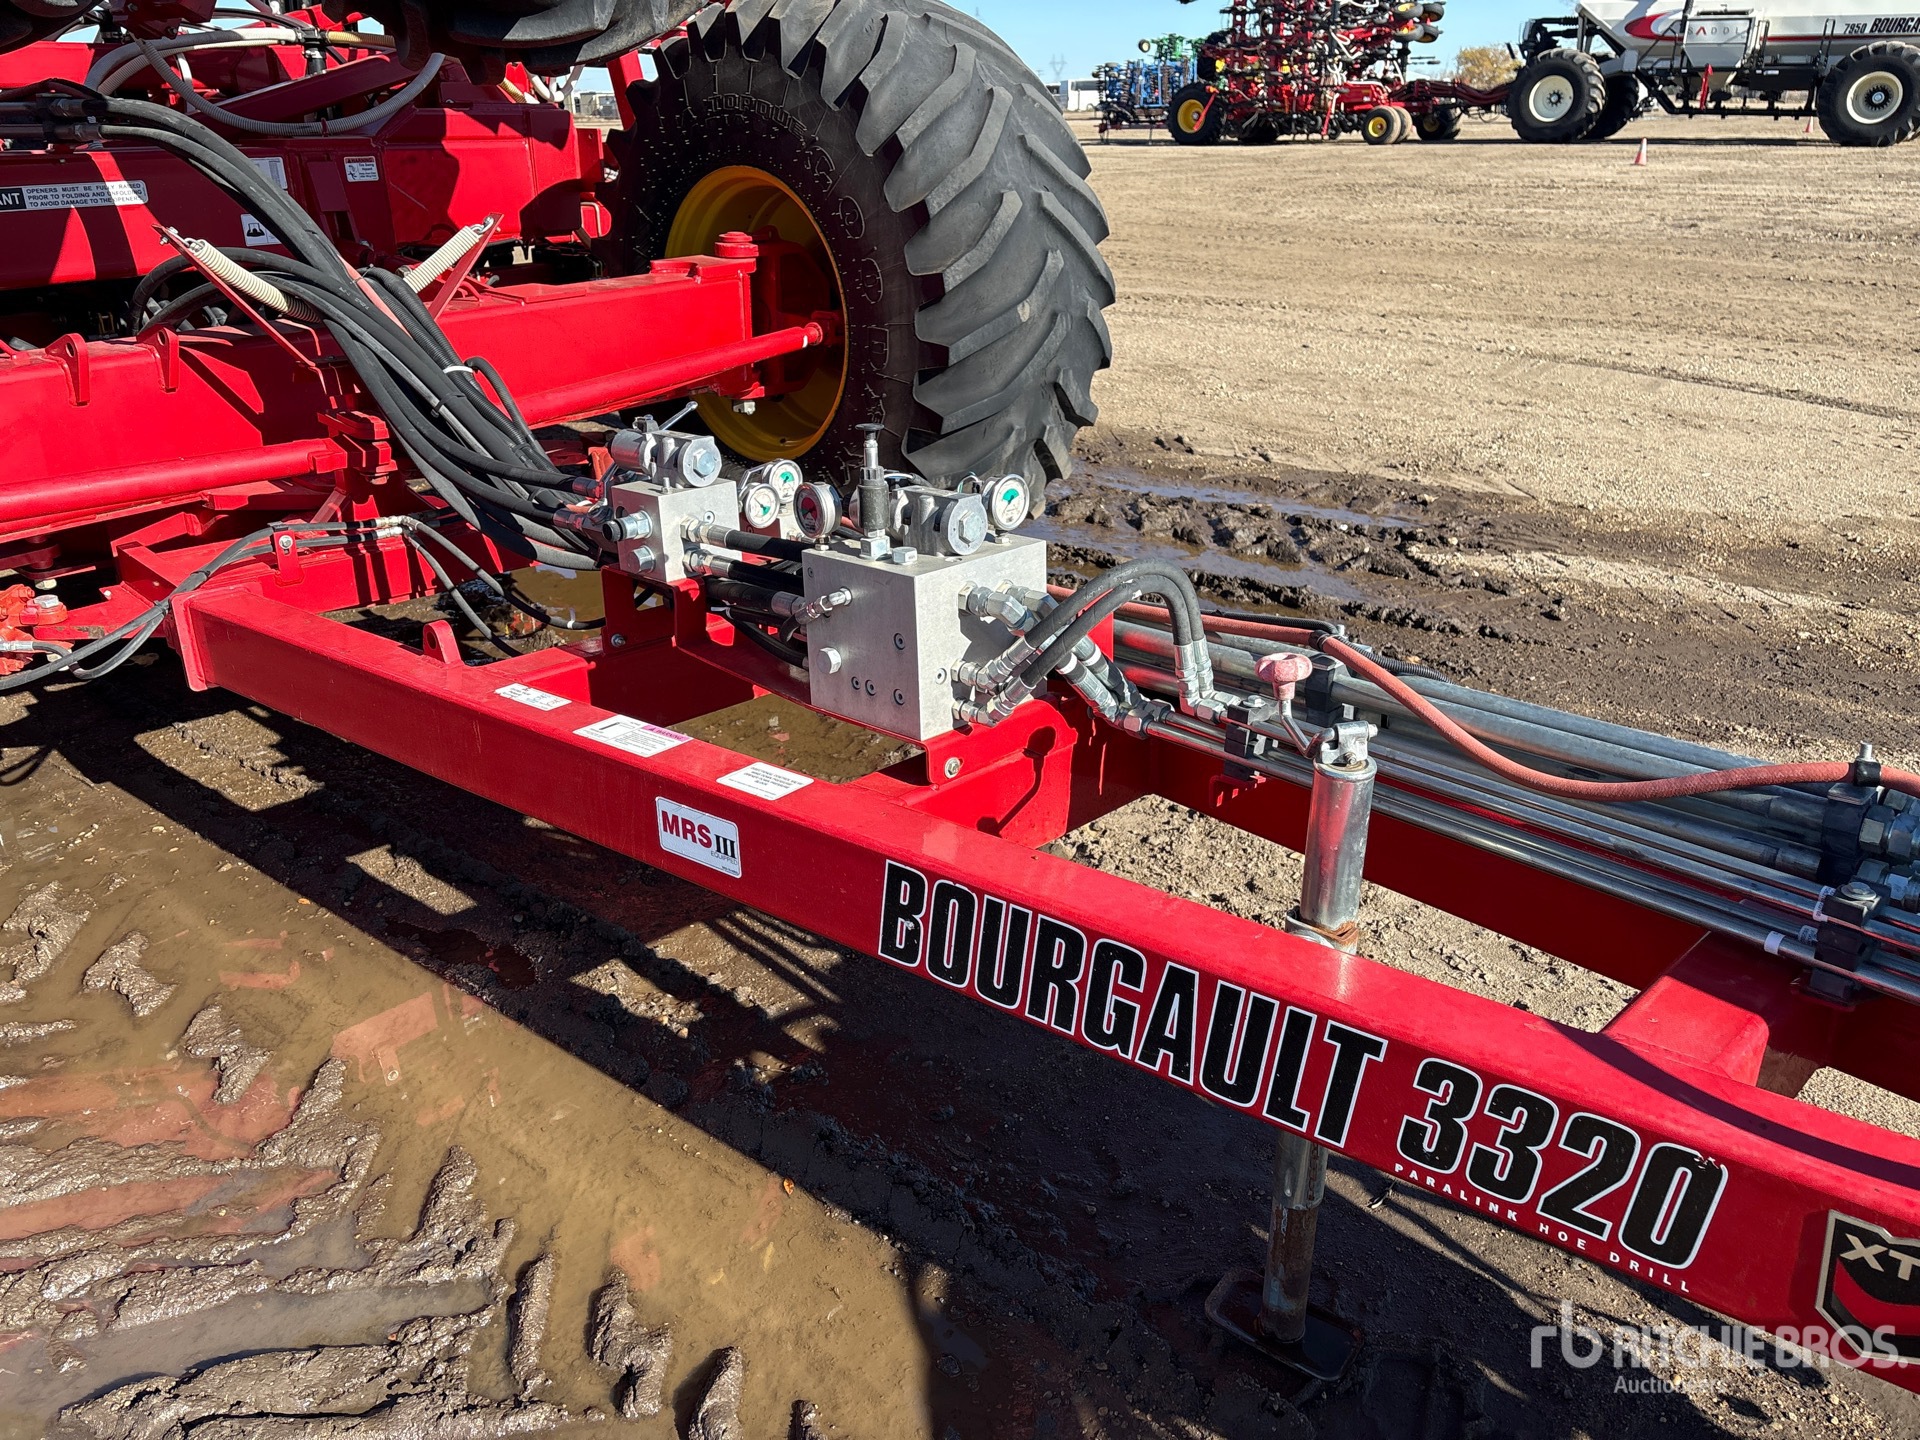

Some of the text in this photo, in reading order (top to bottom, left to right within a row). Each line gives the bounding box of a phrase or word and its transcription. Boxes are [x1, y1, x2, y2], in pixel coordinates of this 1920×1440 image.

[1844, 23, 1867, 34] 7950
[708, 93, 807, 140] TORQUE
[0, 193, 20, 205] NT
[661, 810, 737, 859] MRS III
[711, 850, 738, 865] EQUIPPED
[878, 860, 1729, 1270] BOURGAULT 3320
[1394, 1162, 1691, 1294] PARALINK HOE DRILL
